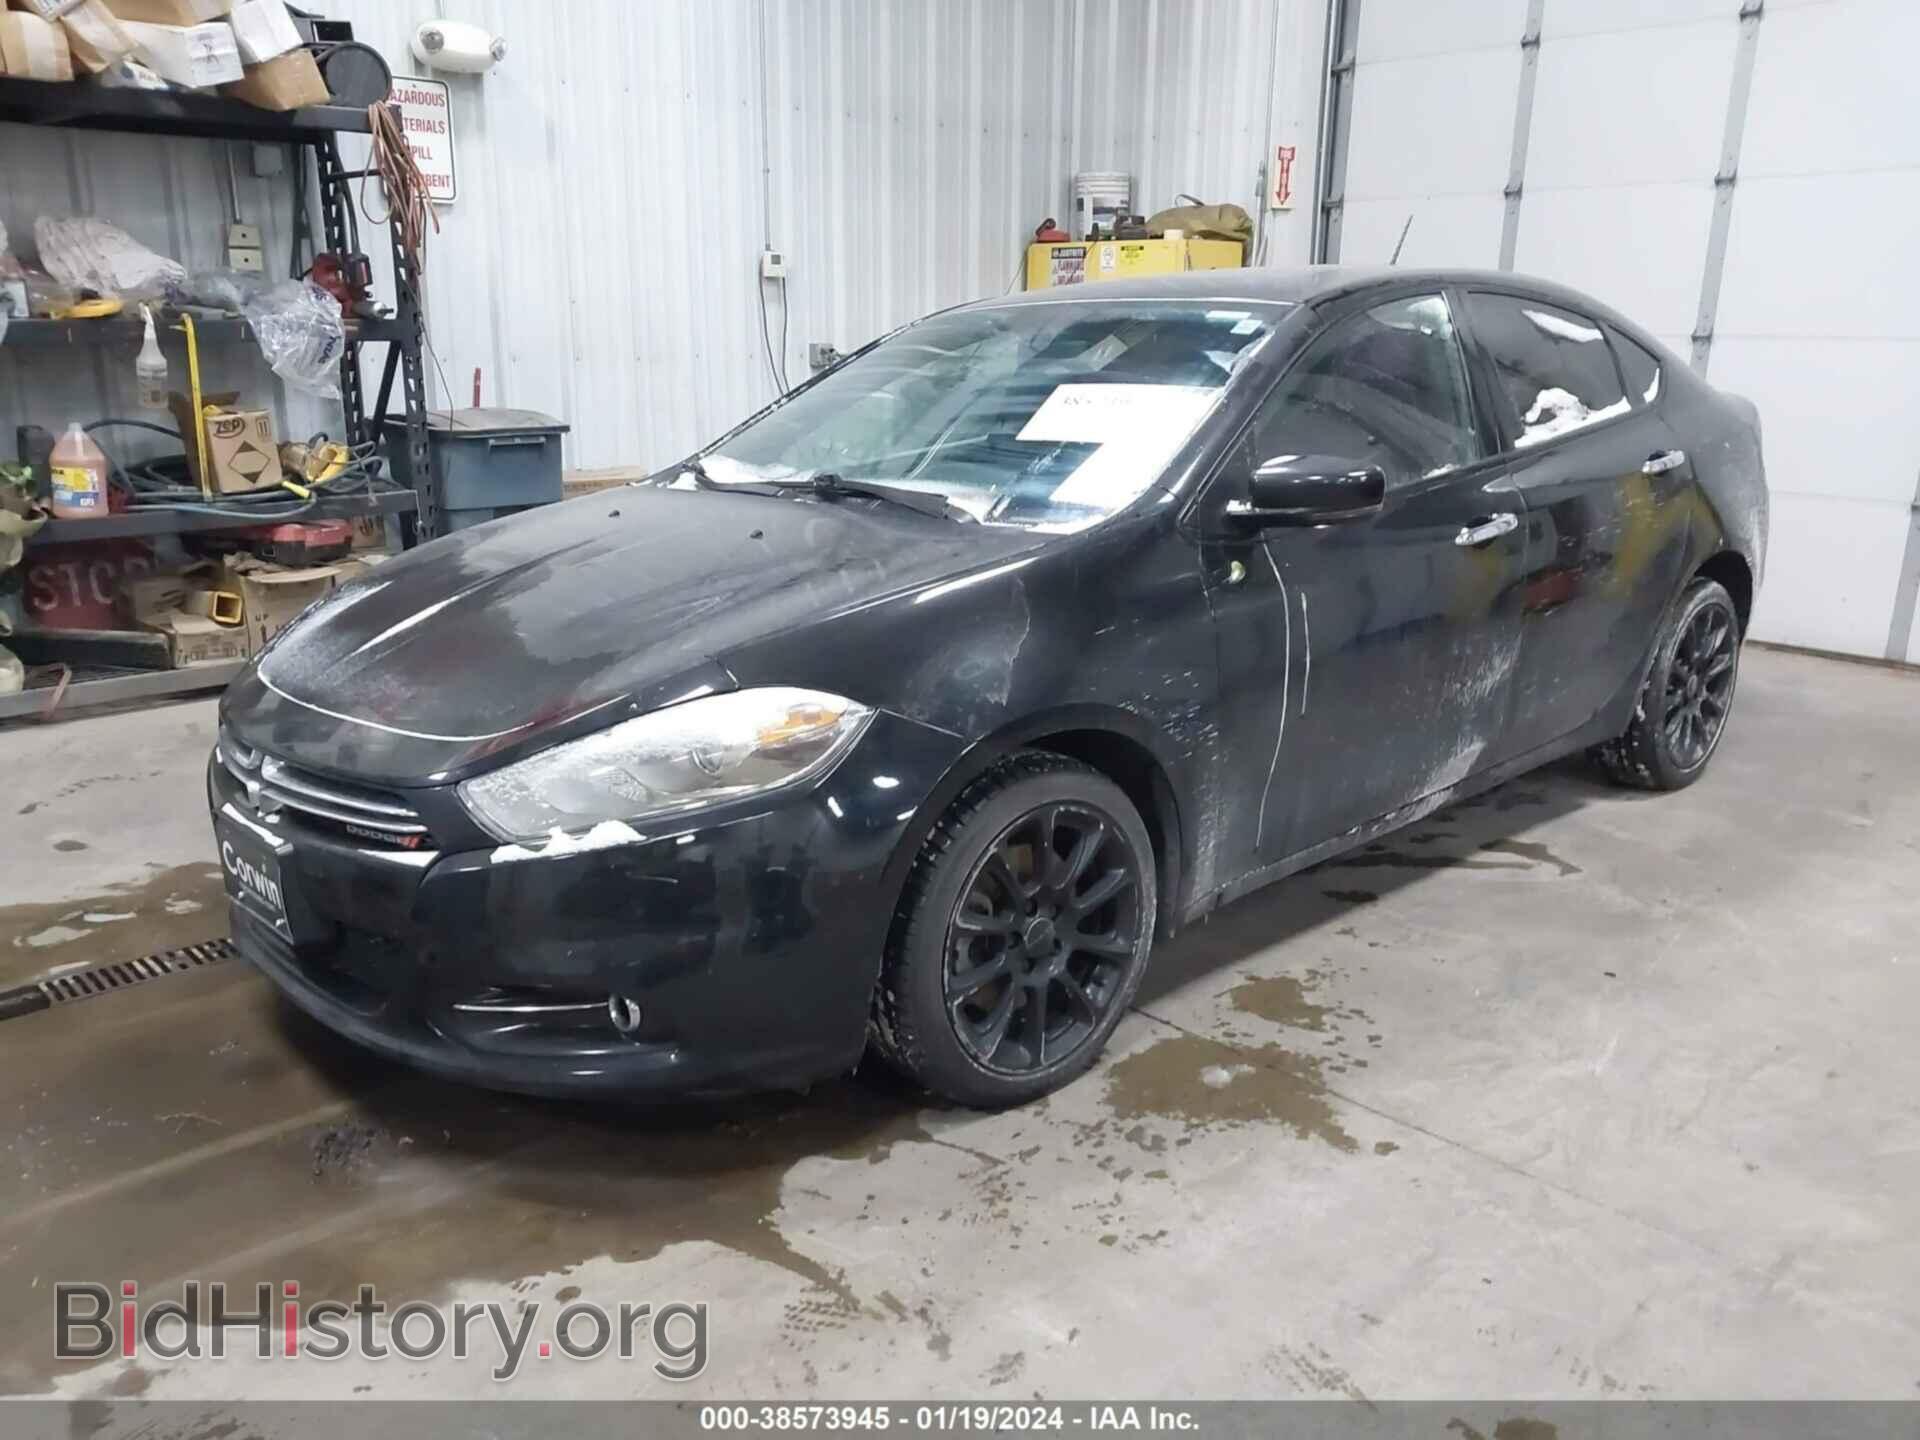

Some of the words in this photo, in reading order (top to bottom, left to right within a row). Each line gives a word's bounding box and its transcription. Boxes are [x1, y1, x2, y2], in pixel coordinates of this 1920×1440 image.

[390, 88, 446, 107] AZARDOUS
[403, 117, 446, 134] TERIALS
[411, 144, 433, 160] PILL
[222, 841, 282, 910] Corwin
